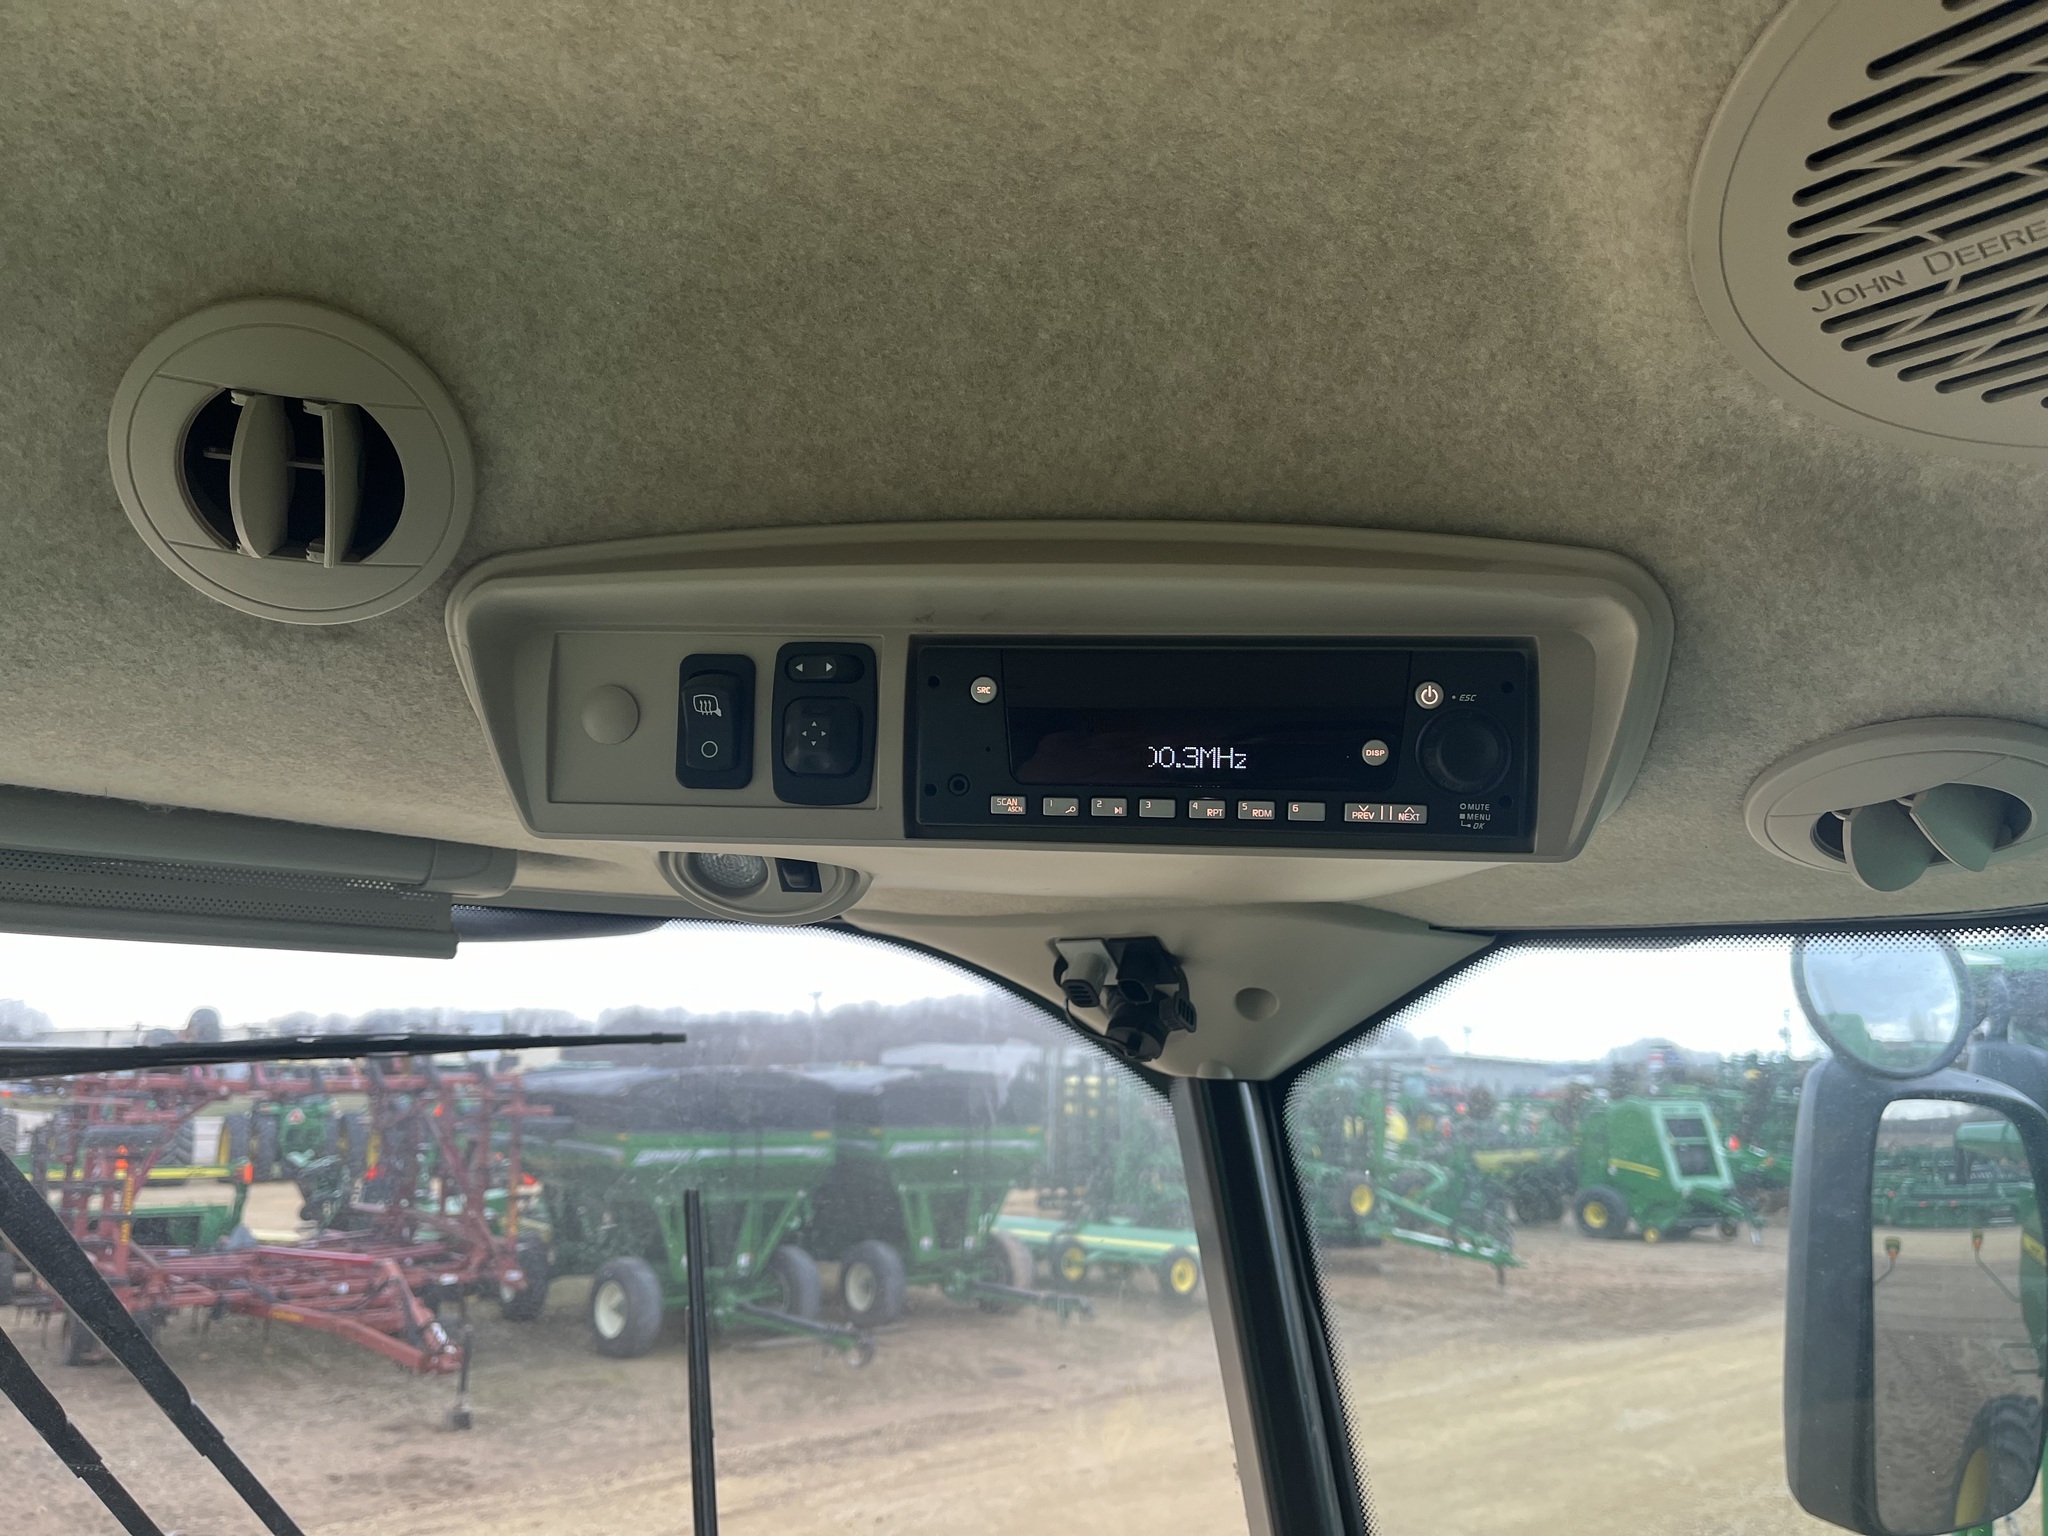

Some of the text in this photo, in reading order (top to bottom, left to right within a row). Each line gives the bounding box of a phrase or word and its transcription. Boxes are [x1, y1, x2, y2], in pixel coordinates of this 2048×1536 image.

[1811, 219, 2048, 313] JOHN DEERE
[976, 685, 991, 694] SRC
[1459, 694, 1477, 702] ESC
[1365, 749, 1386, 757] DISP
[996, 797, 1018, 806] SCAN
[1096, 799, 1103, 808] 2
[1145, 801, 1151, 809] 3
[1192, 802, 1198, 810] 4
[1242, 802, 1248, 811] 5
[1292, 804, 1299, 812] 6
[1467, 803, 1490, 811] MUTE
[1206, 808, 1224, 817] RPT
[1252, 809, 1272, 818] RDM
[1351, 811, 1375, 820] PREV
[1398, 813, 1420, 821] NEXT
[1466, 813, 1491, 821] MENU
[1472, 822, 1485, 830] OK
